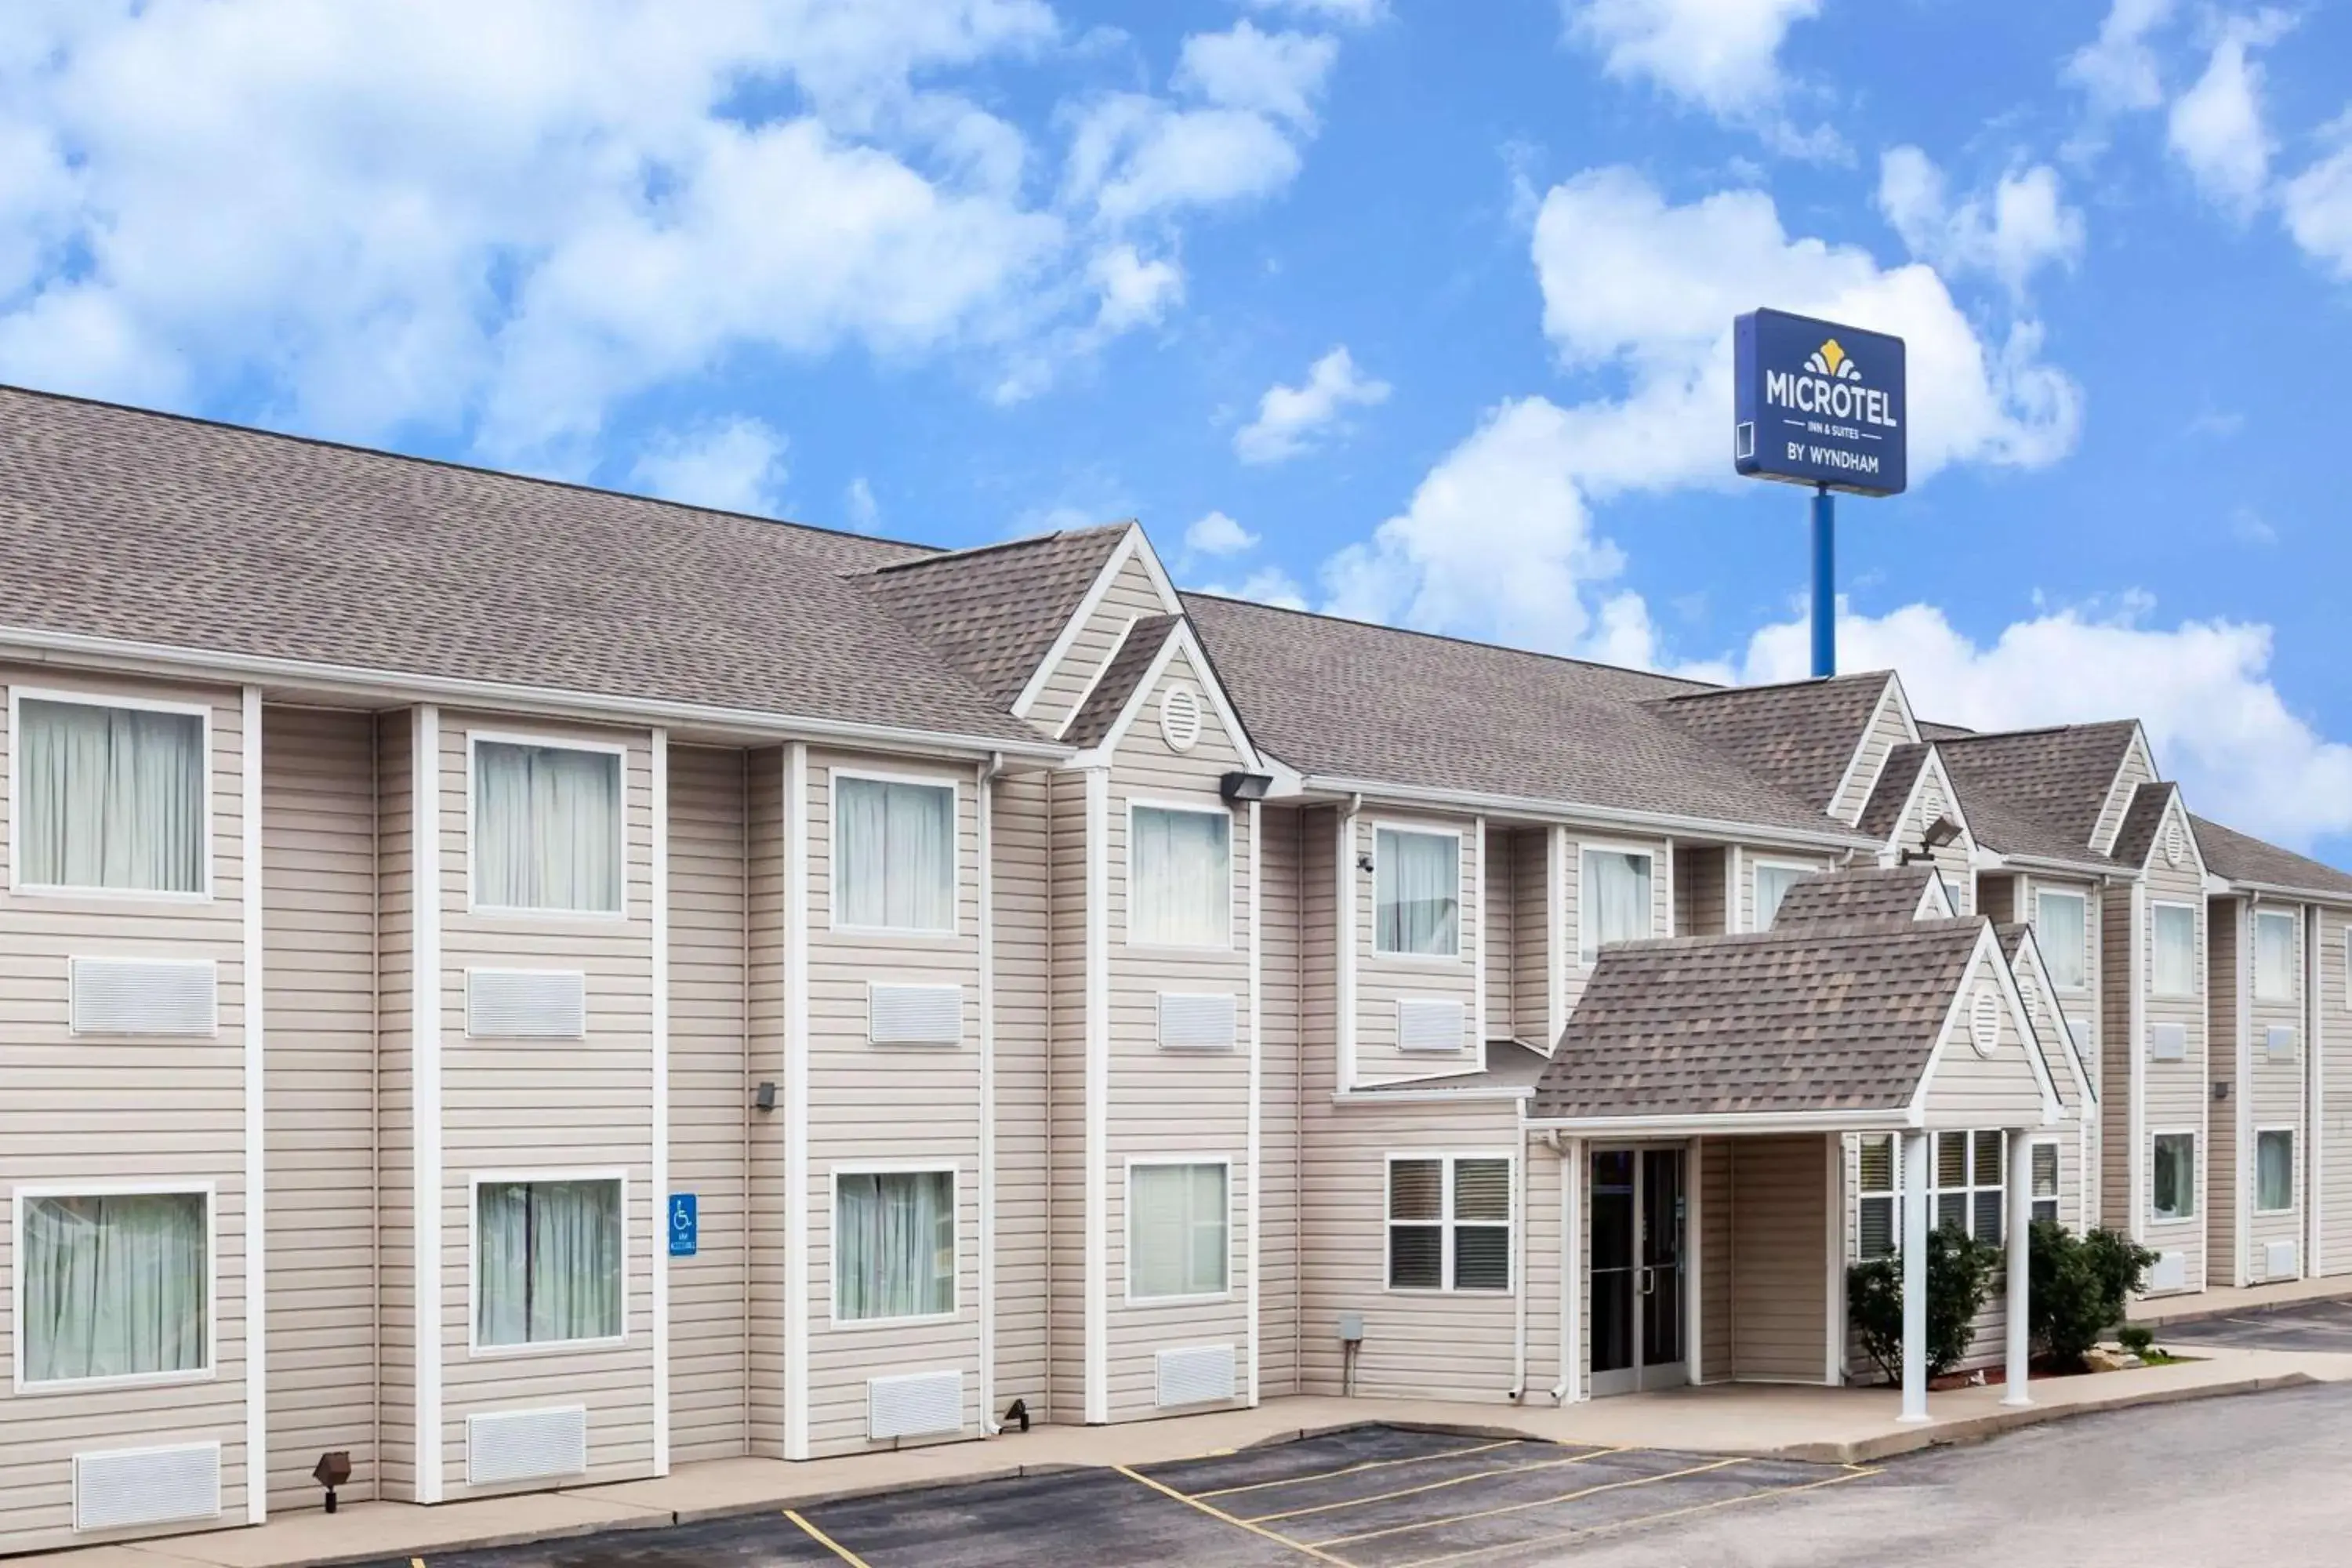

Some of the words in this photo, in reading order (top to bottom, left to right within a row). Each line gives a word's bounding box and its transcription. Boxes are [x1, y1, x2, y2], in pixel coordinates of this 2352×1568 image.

[1766, 369, 1896, 426] MICROTEL
[1808, 422, 1823, 434] INN
[1824, 424, 1831, 434] &
[1831, 425, 1860, 439] SUITES
[1788, 441, 1804, 461] BY
[1810, 445, 1878, 473] WYNDHAM
